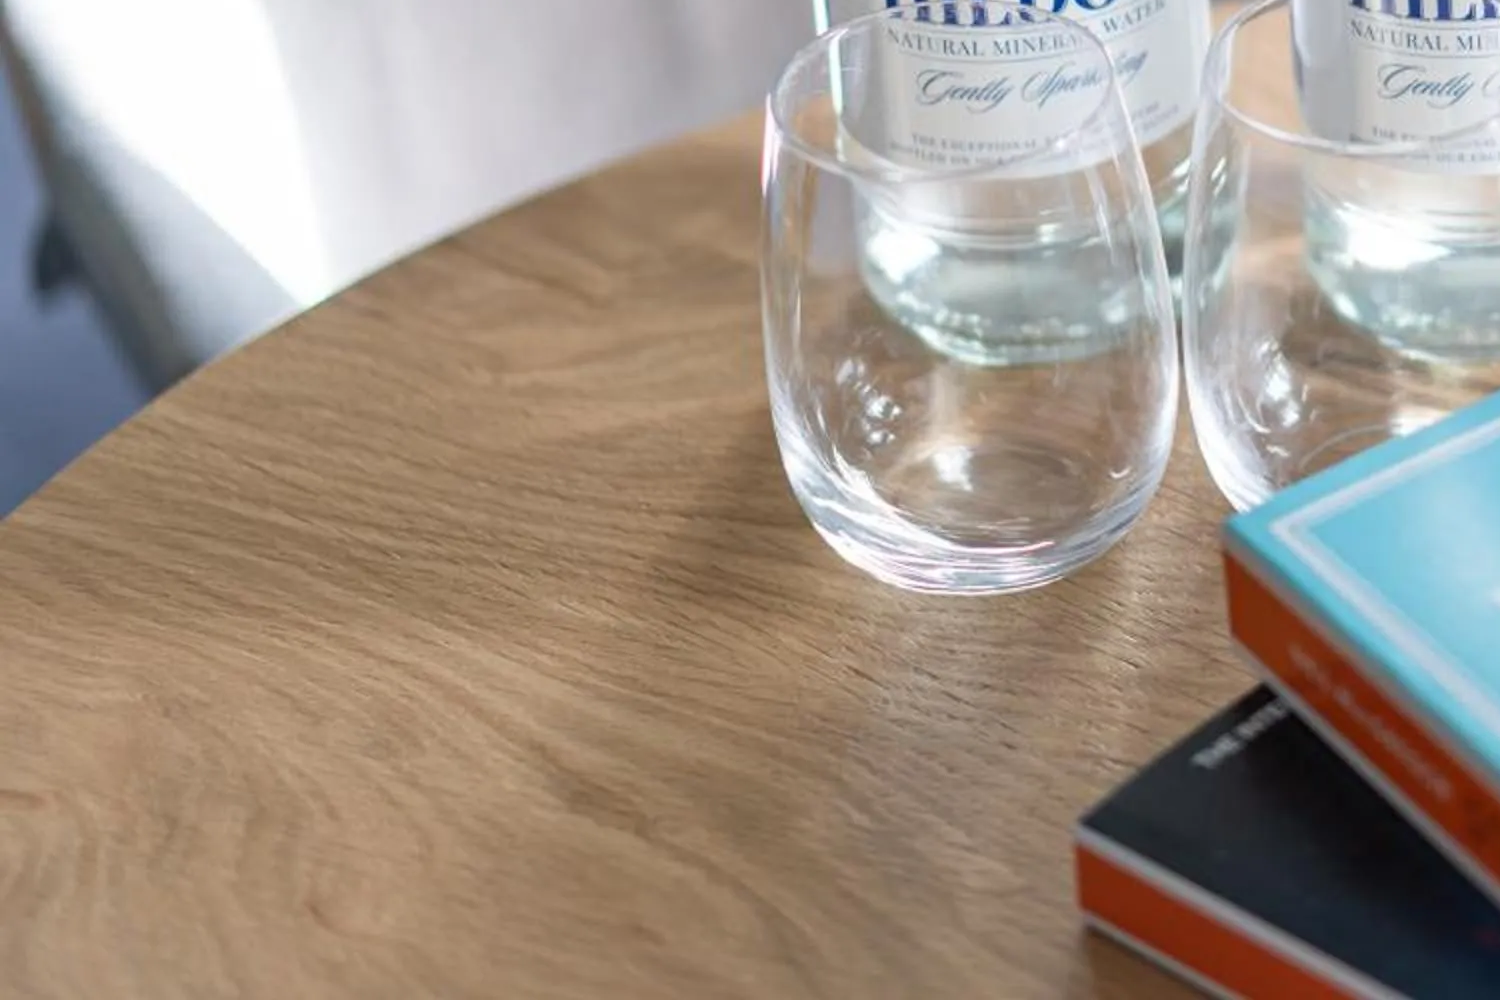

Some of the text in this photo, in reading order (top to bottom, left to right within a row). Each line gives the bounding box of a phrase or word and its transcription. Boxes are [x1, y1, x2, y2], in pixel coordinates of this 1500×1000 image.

[885, 27, 986, 57] NATURAL
[992, 28, 1092, 56] MINERA
[1347, 18, 1448, 52] NATURAL
[915, 68, 1014, 113] Gently
[1377, 63, 1476, 109] Gently
